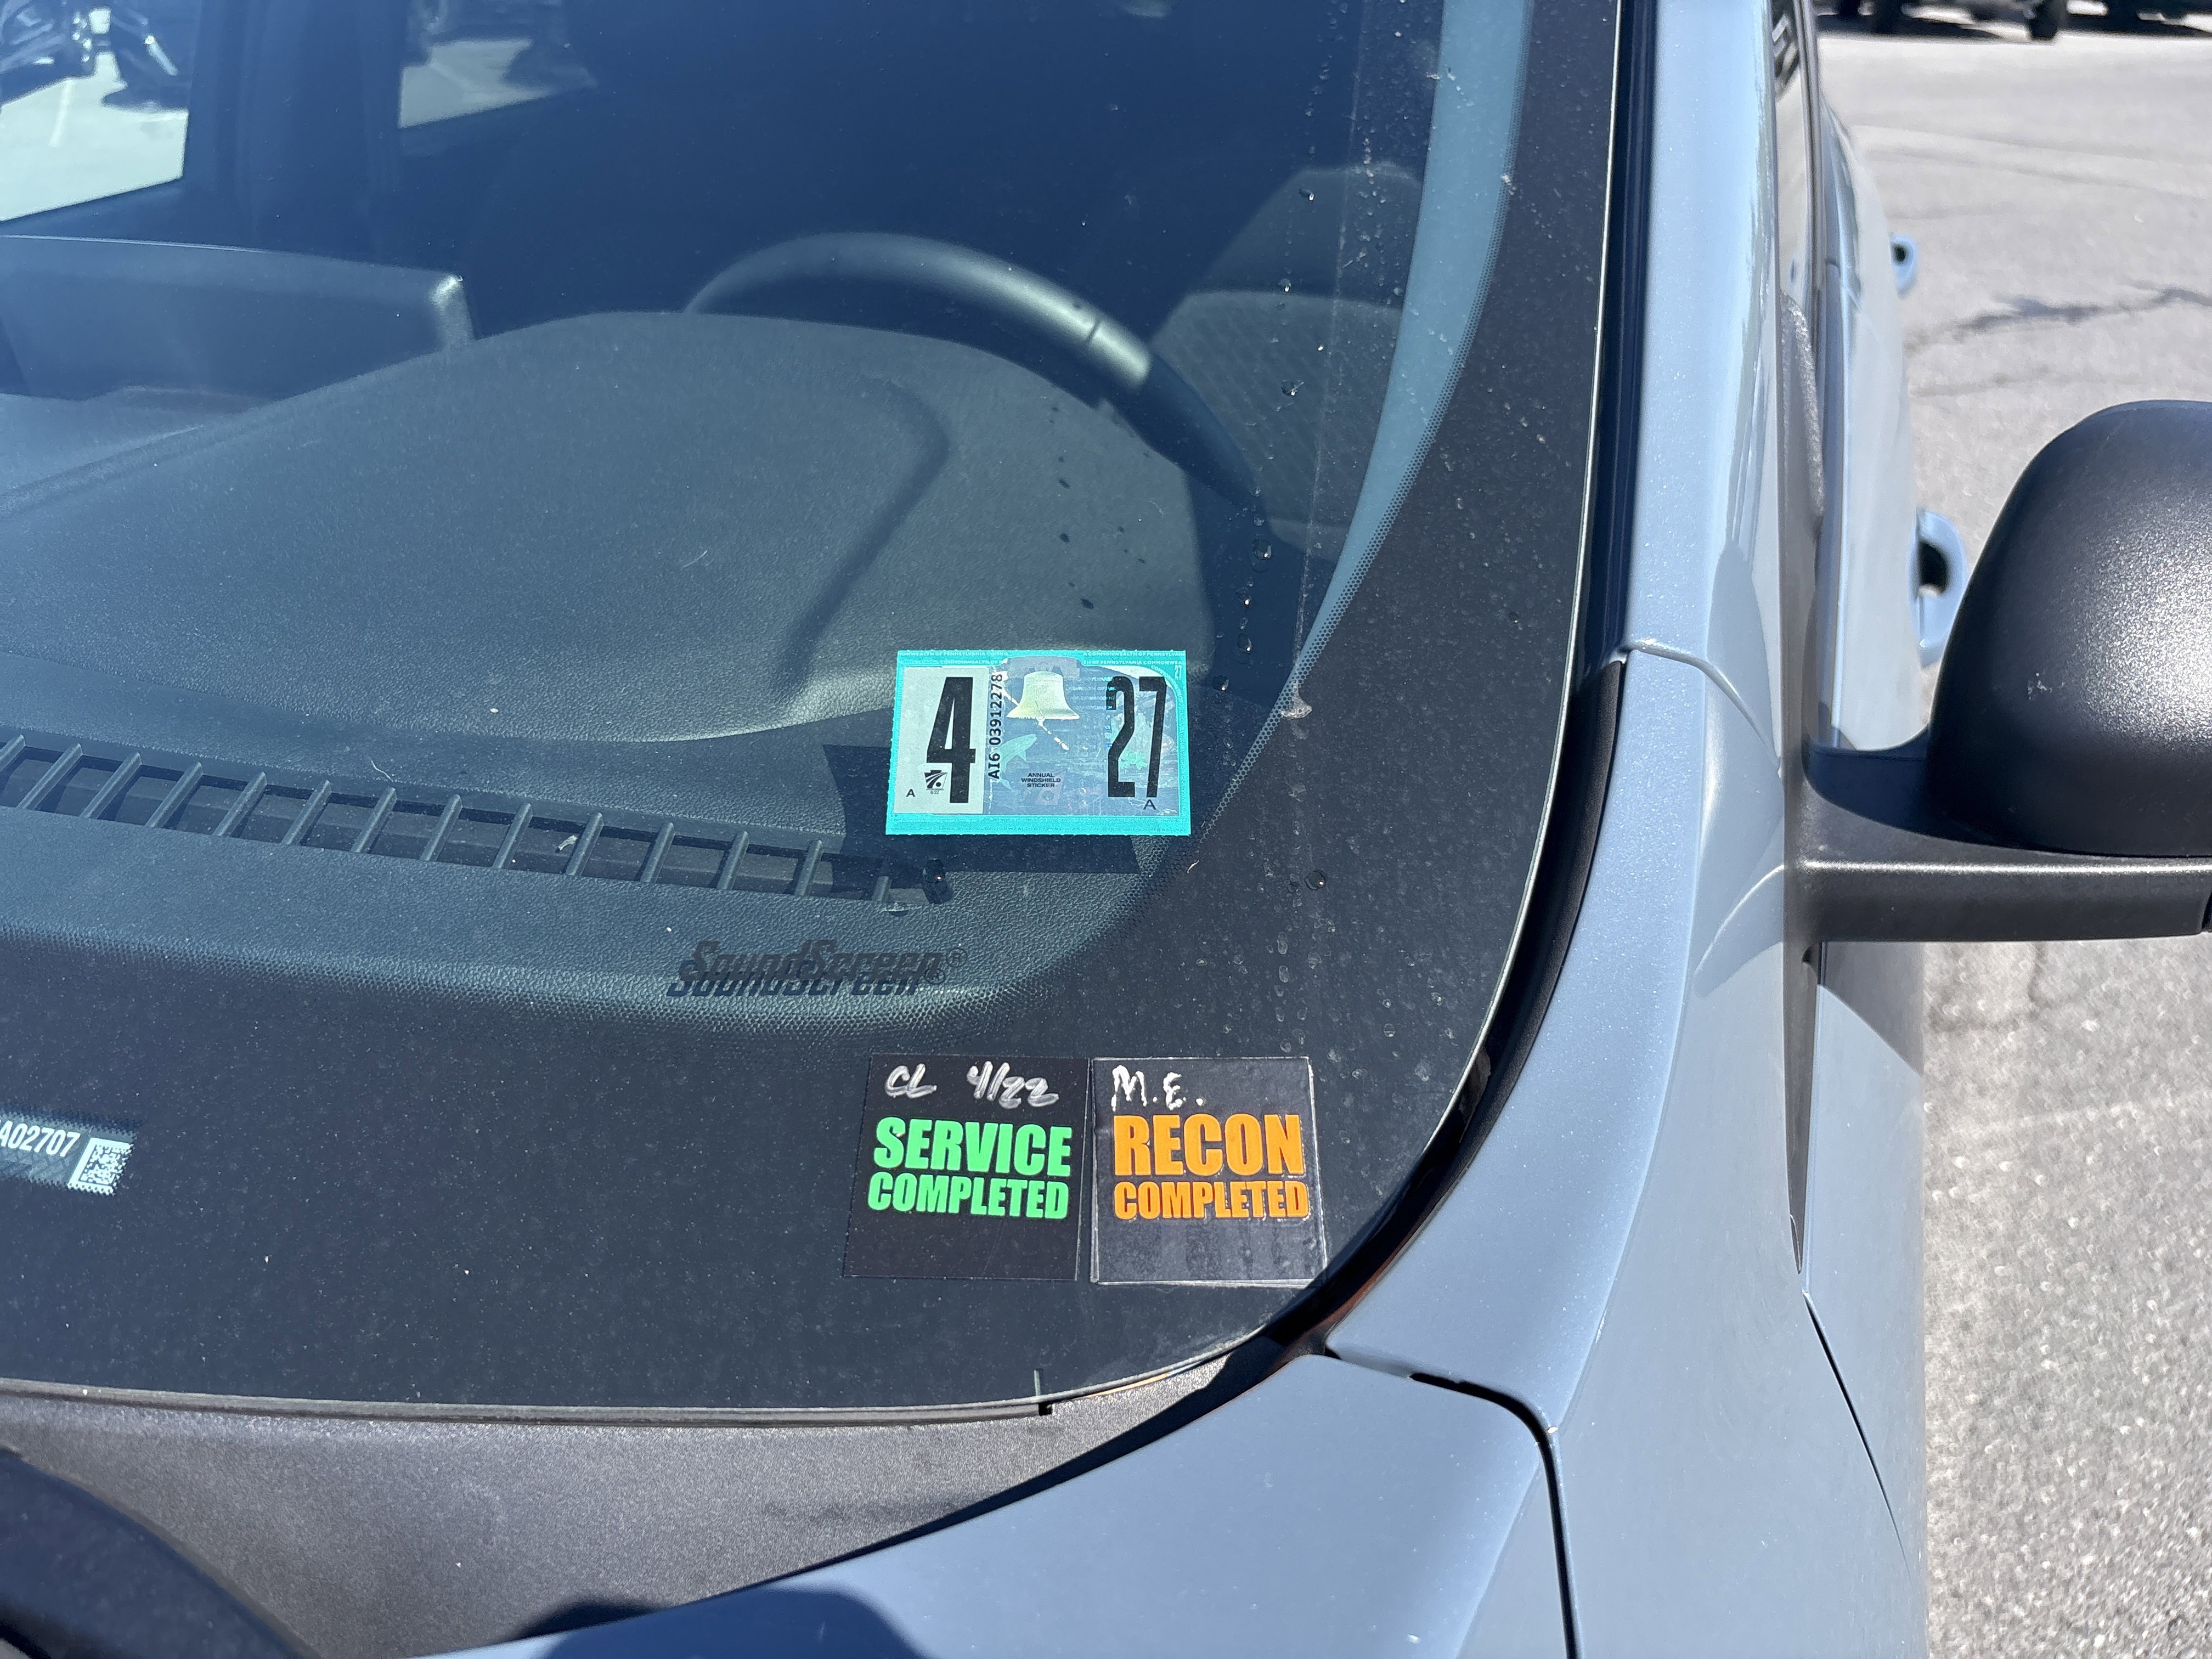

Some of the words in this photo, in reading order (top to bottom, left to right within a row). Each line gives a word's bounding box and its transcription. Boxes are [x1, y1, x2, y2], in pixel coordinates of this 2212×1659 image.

[989, 674, 1003, 746] 03912278
[1106, 676, 1167, 798] 27
[926, 676, 976, 803] 4
[906, 788, 916, 798] A
[1143, 799, 1156, 810] A
[0, 1120, 81, 1158] A02707
[873, 1117, 1073, 1177] SERVICE
[1114, 1113, 1305, 1176] RECON
[868, 1171, 1069, 1220] COMPLETED
[1114, 1181, 1309, 1220] COMPLETED
